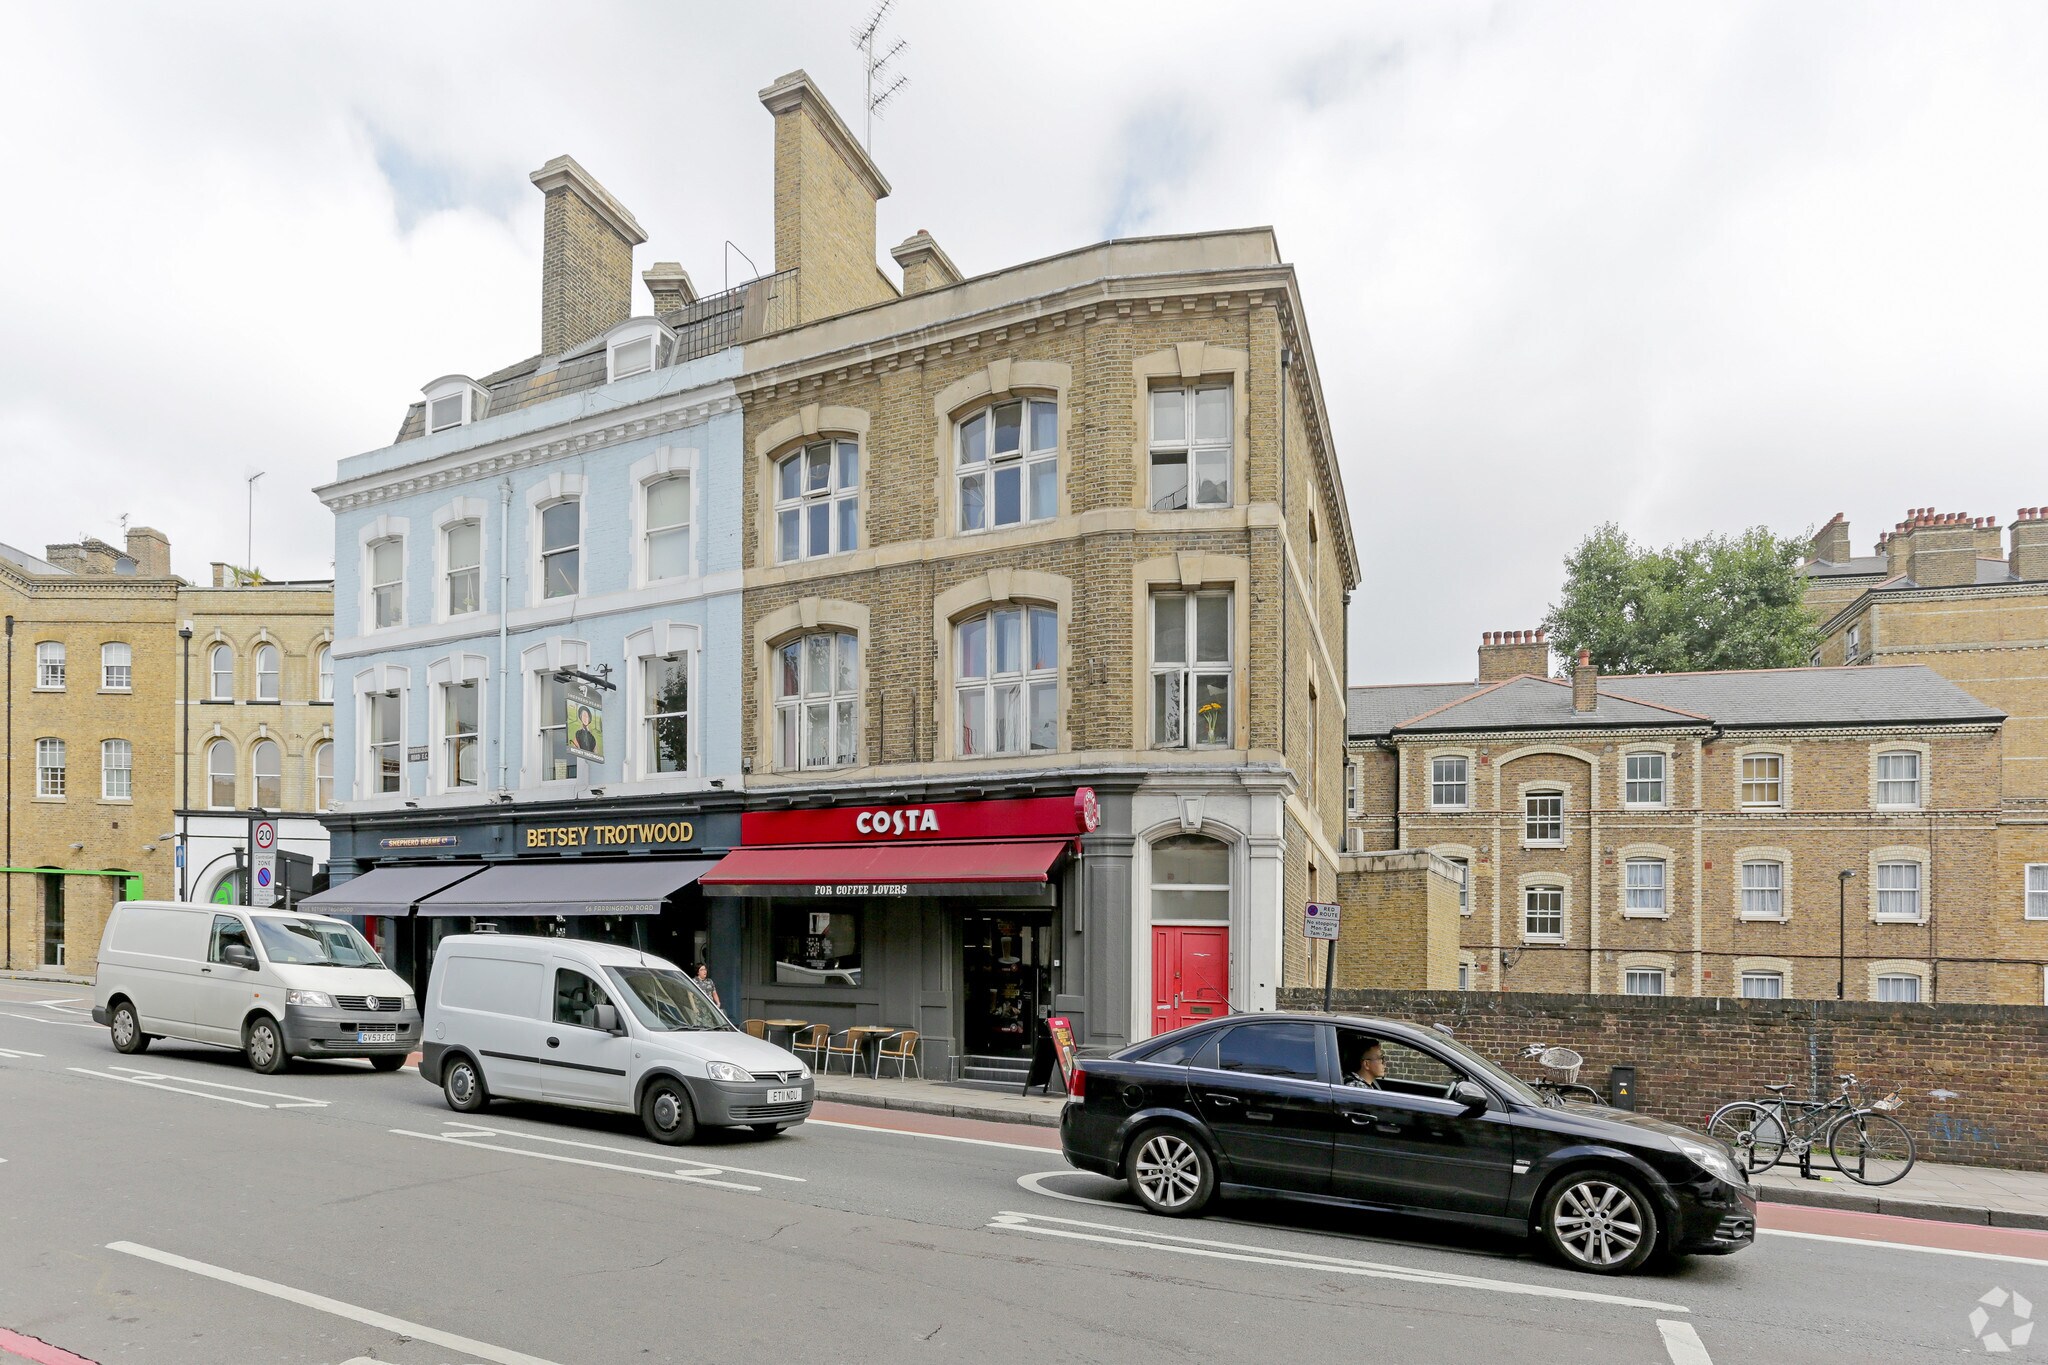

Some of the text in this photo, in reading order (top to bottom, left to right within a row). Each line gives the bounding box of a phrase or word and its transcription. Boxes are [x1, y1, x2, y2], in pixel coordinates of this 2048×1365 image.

[856, 809, 940, 836] COSTA
[259, 830, 271, 841] 20
[527, 821, 694, 848] BETSEY TROTWOOD
[388, 839, 419, 847] SHEPHERD
[421, 837, 440, 846] NEAME
[814, 884, 908, 895] FOR COFFEE LOVERS
[1315, 920, 1338, 928] stopping
[362, 1033, 381, 1042] GV53
